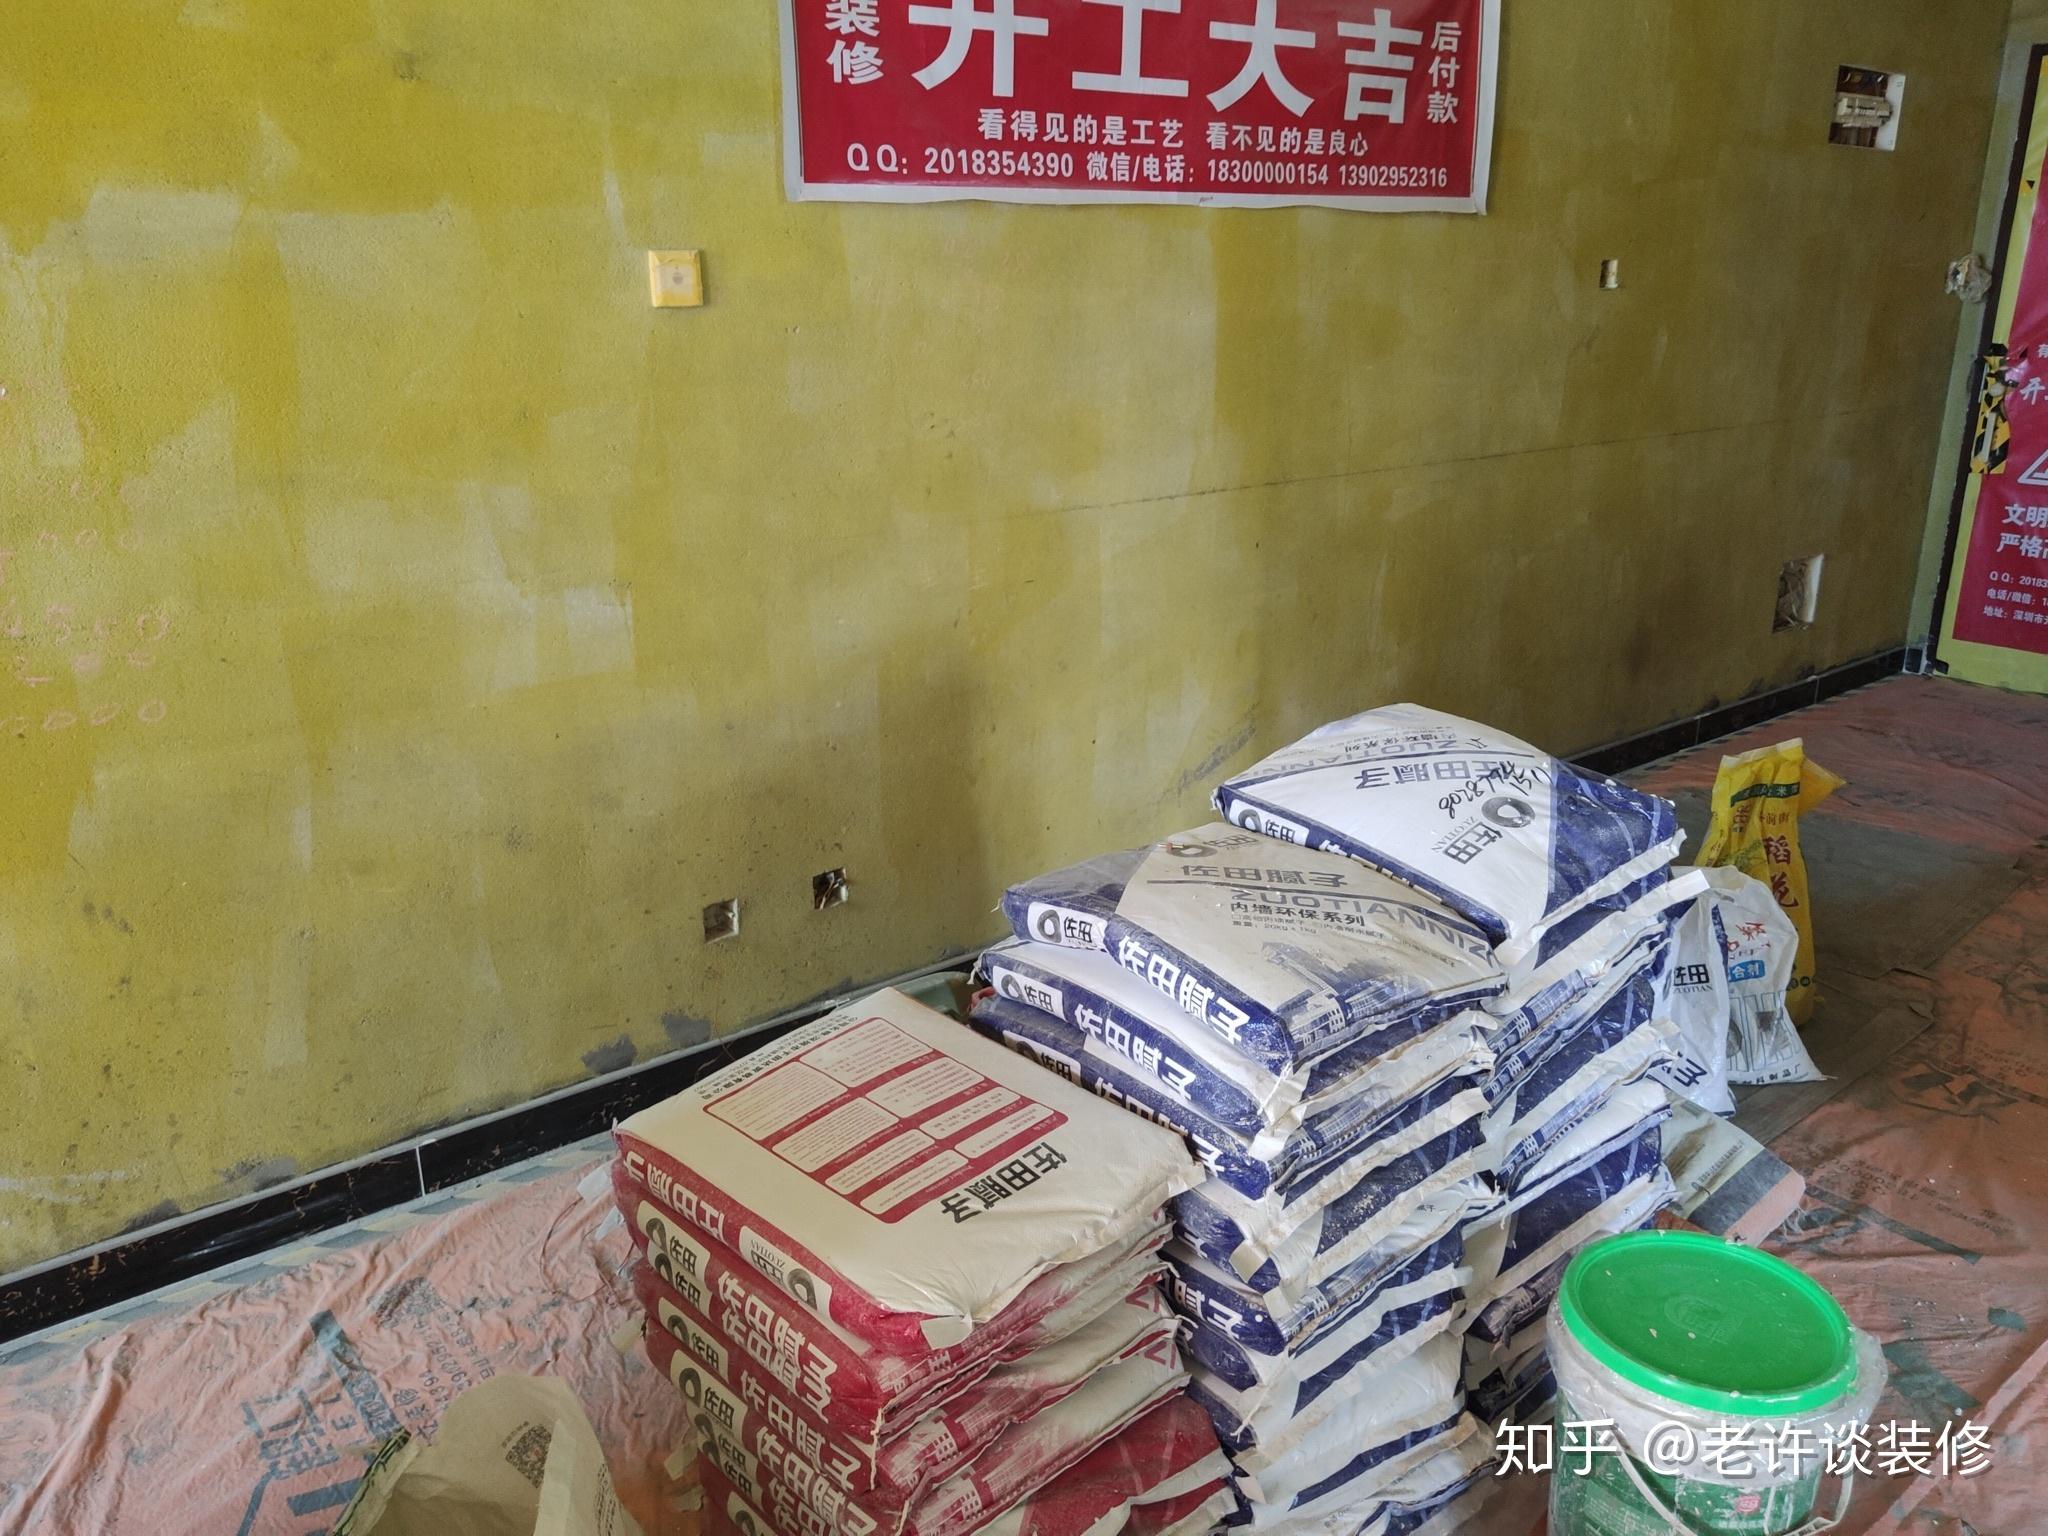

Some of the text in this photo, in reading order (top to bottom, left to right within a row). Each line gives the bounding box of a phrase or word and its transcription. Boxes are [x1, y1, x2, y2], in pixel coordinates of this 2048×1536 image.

[825, 0, 884, 85] 装修
[1427, 21, 1462, 124] 后付款
[977, 107, 1369, 157] 看得见的是工艺 看不见的是良心
[924, 147, 1074, 178] 2018354390
[1207, 158, 1329, 185] 18300000154
[1339, 165, 1448, 188] 13902952316
[1997, 532, 2048, 560] 严格
[1264, 817, 1297, 844] 佐田
[1443, 821, 1504, 865] 佐田
[1181, 864, 1348, 888] 佐田腻子
[1063, 915, 1093, 944] 佐田
[1230, 902, 1366, 928] 内墙环保系列
[1024, 984, 1055, 1014] 佐田
[1118, 934, 1251, 1045] 佐田腻子
[1074, 1003, 1197, 1101] 佐田腻子
[941, 1141, 1068, 1224] 佐田腻子
[669, 1235, 698, 1278] 佐田
[675, 1271, 701, 1310] 佐田
[692, 1332, 720, 1372] 佐田
[718, 1270, 838, 1394] 佐田腻子
[704, 1386, 735, 1430] 佐田
[740, 1369, 861, 1492] 佐田腻子
